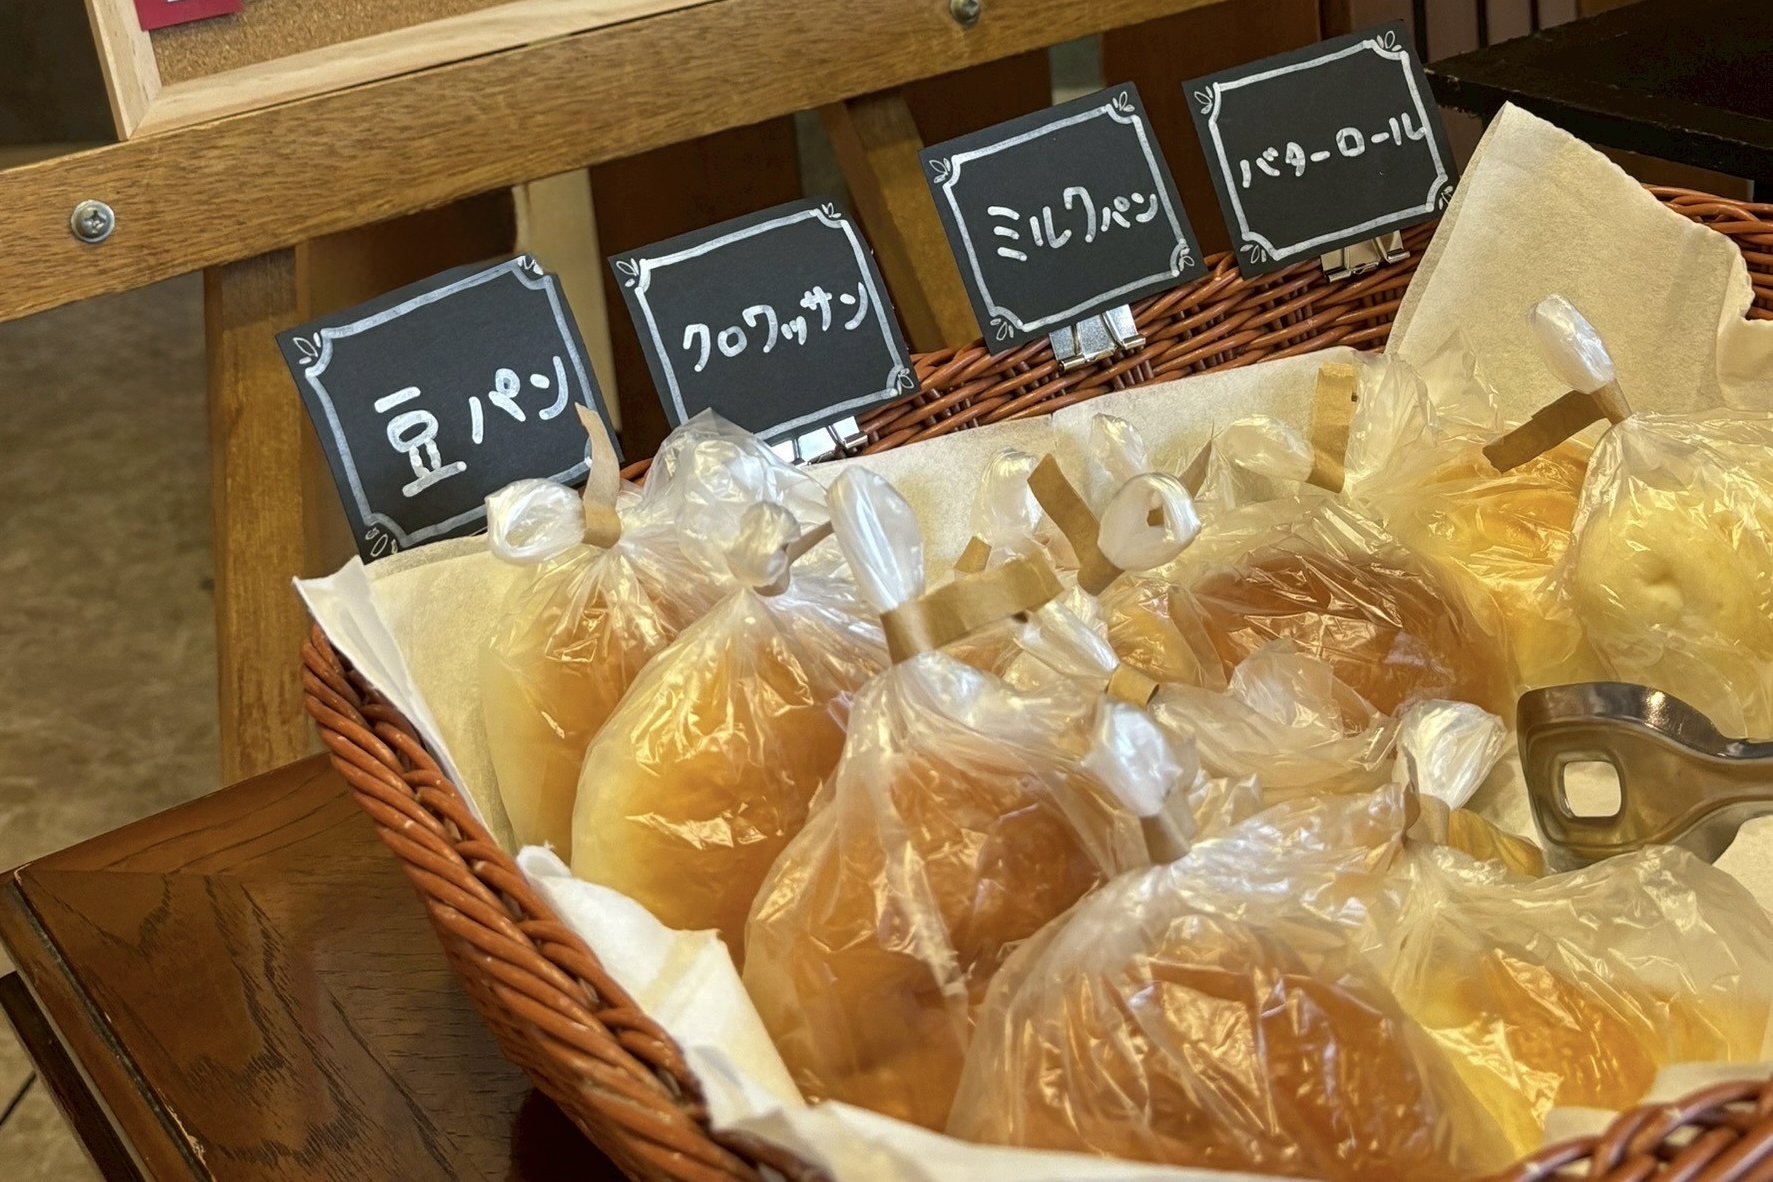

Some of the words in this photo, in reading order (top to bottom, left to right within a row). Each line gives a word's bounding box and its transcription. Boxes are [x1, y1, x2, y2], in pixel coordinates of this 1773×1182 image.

[1239, 112, 1428, 189] バターロール
[986, 185, 1159, 262] ミルクパン
[682, 281, 869, 373] クロワッサン
[373, 355, 569, 498] 豆パン
